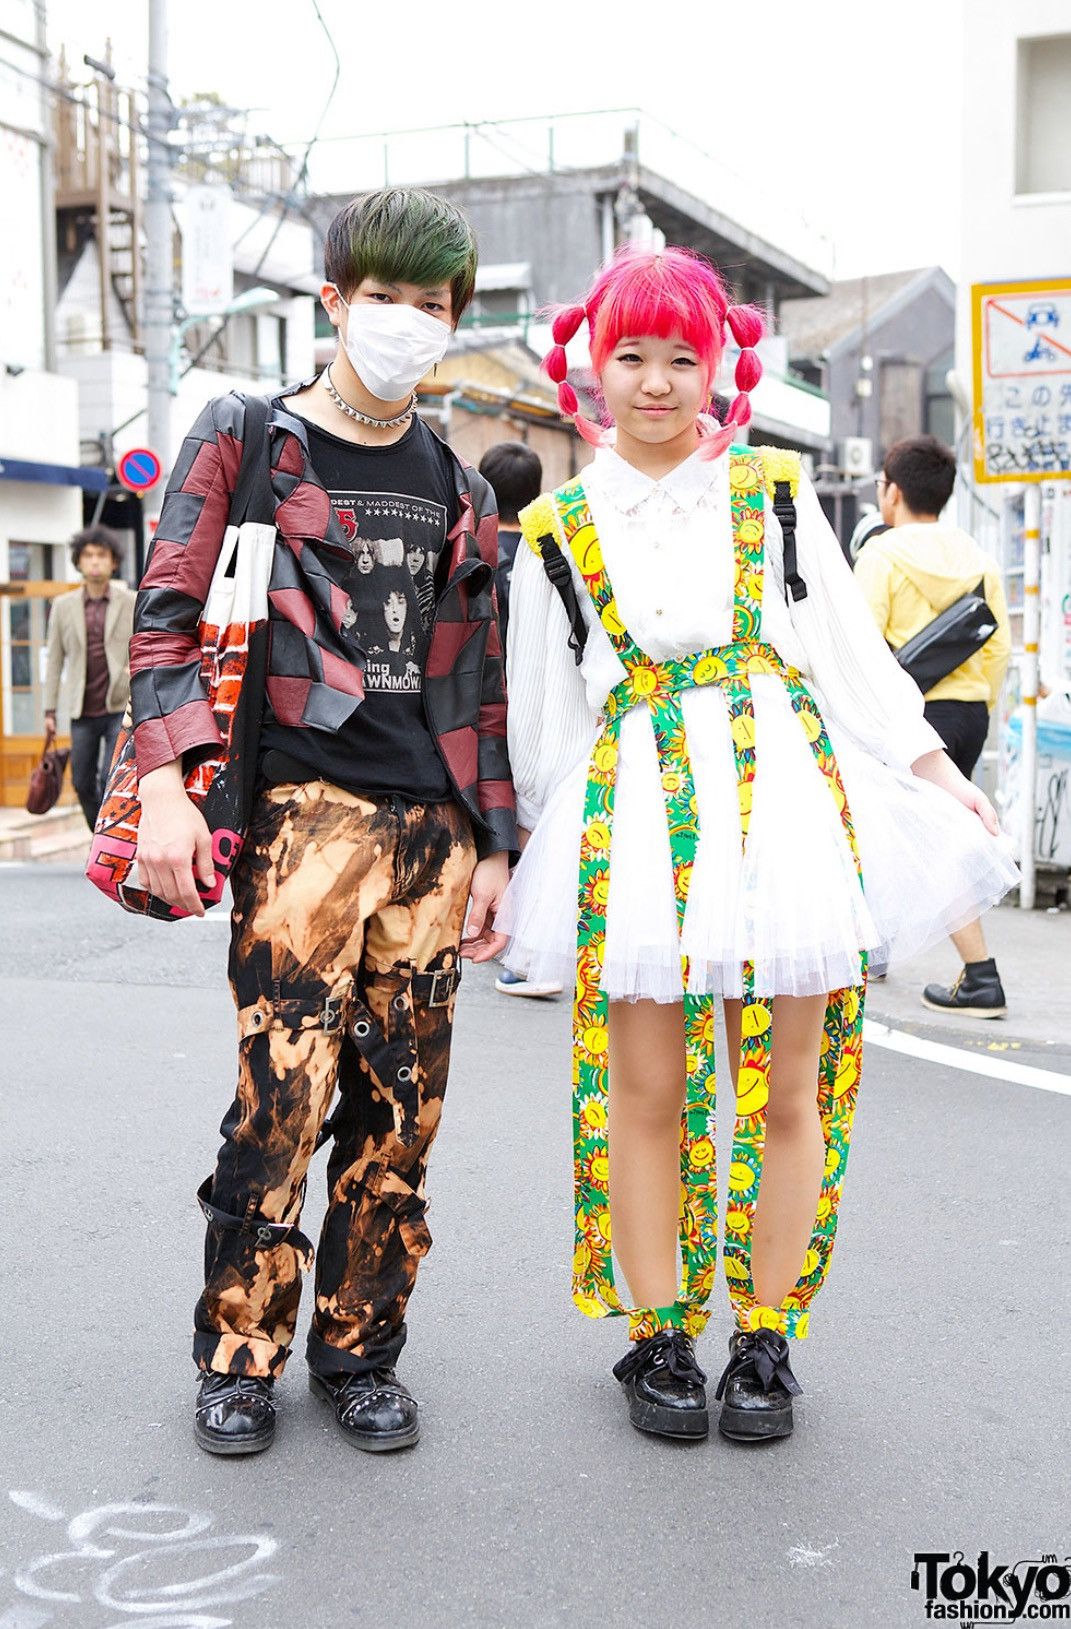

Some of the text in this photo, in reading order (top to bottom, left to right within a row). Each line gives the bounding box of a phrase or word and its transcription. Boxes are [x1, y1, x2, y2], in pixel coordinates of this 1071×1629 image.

[366, 500, 410, 511] MADDEST
[411, 504, 423, 512] OF
[424, 507, 442, 519] THE
[364, 659, 390, 677] ing
